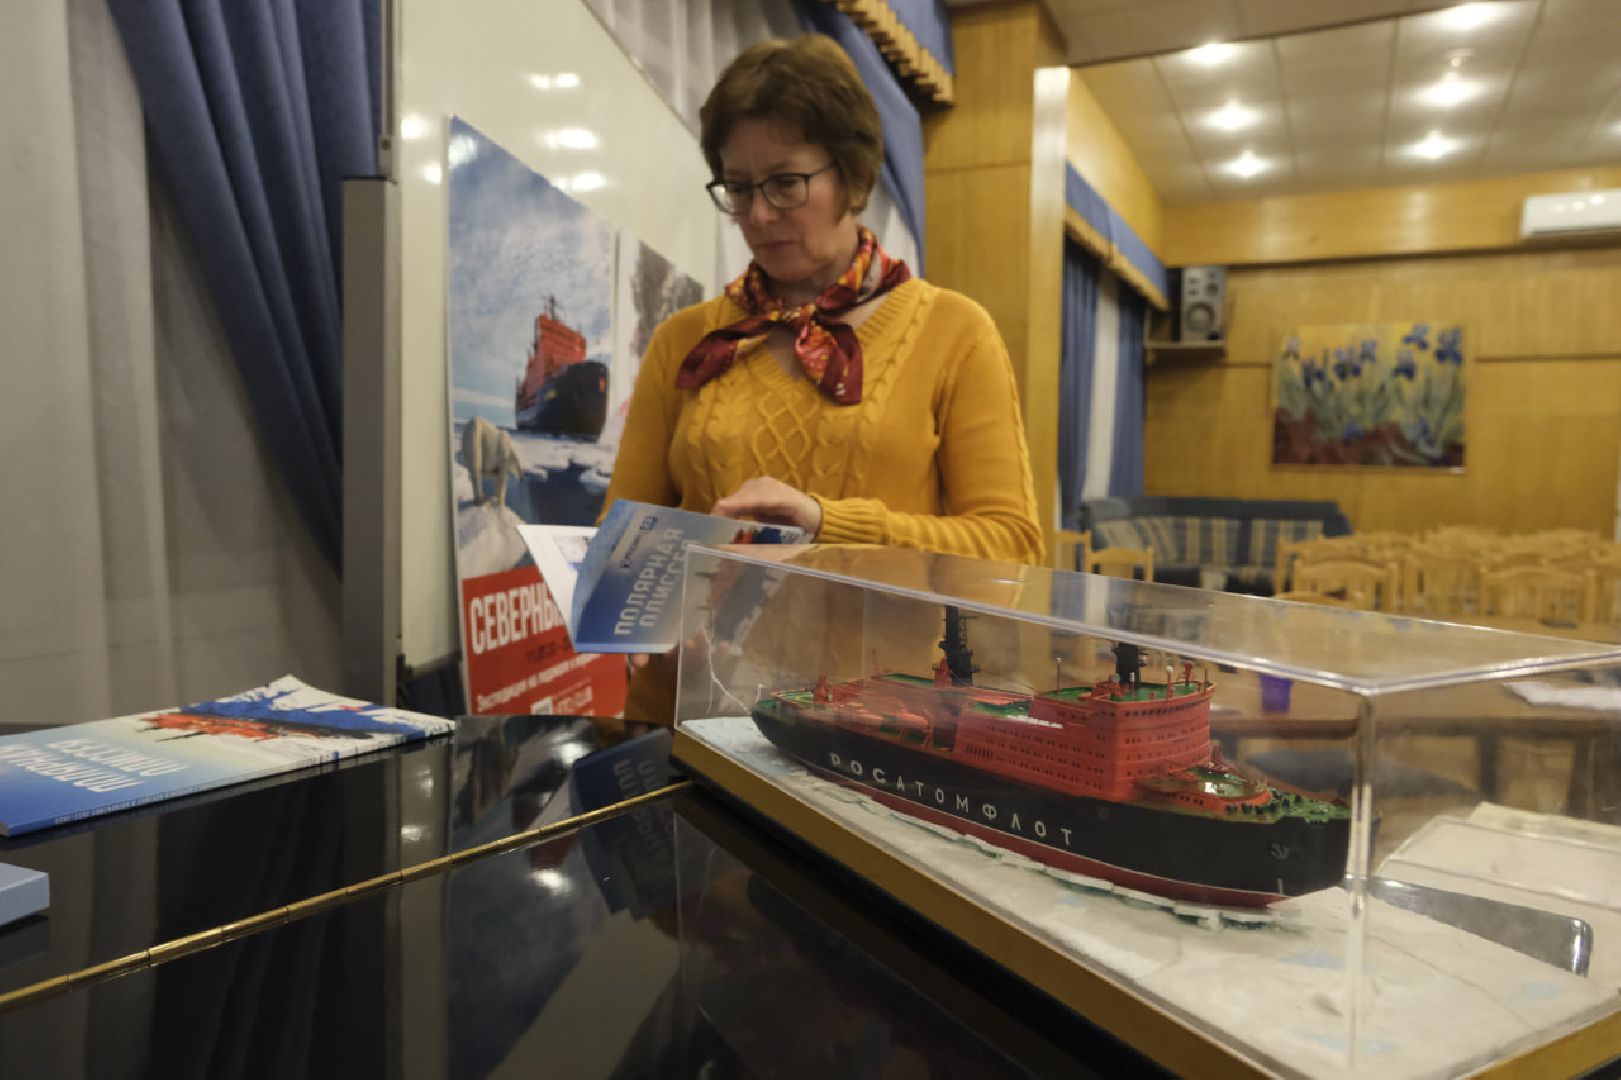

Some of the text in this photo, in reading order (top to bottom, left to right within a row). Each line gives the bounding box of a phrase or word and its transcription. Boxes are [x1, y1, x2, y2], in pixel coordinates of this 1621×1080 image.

[470, 581, 566, 655] СЕВЕРНЫ
[614, 528, 684, 635] ПОЛЯРНАЯ
[829, 752, 1073, 846] РОСАТОМФЛОТ
